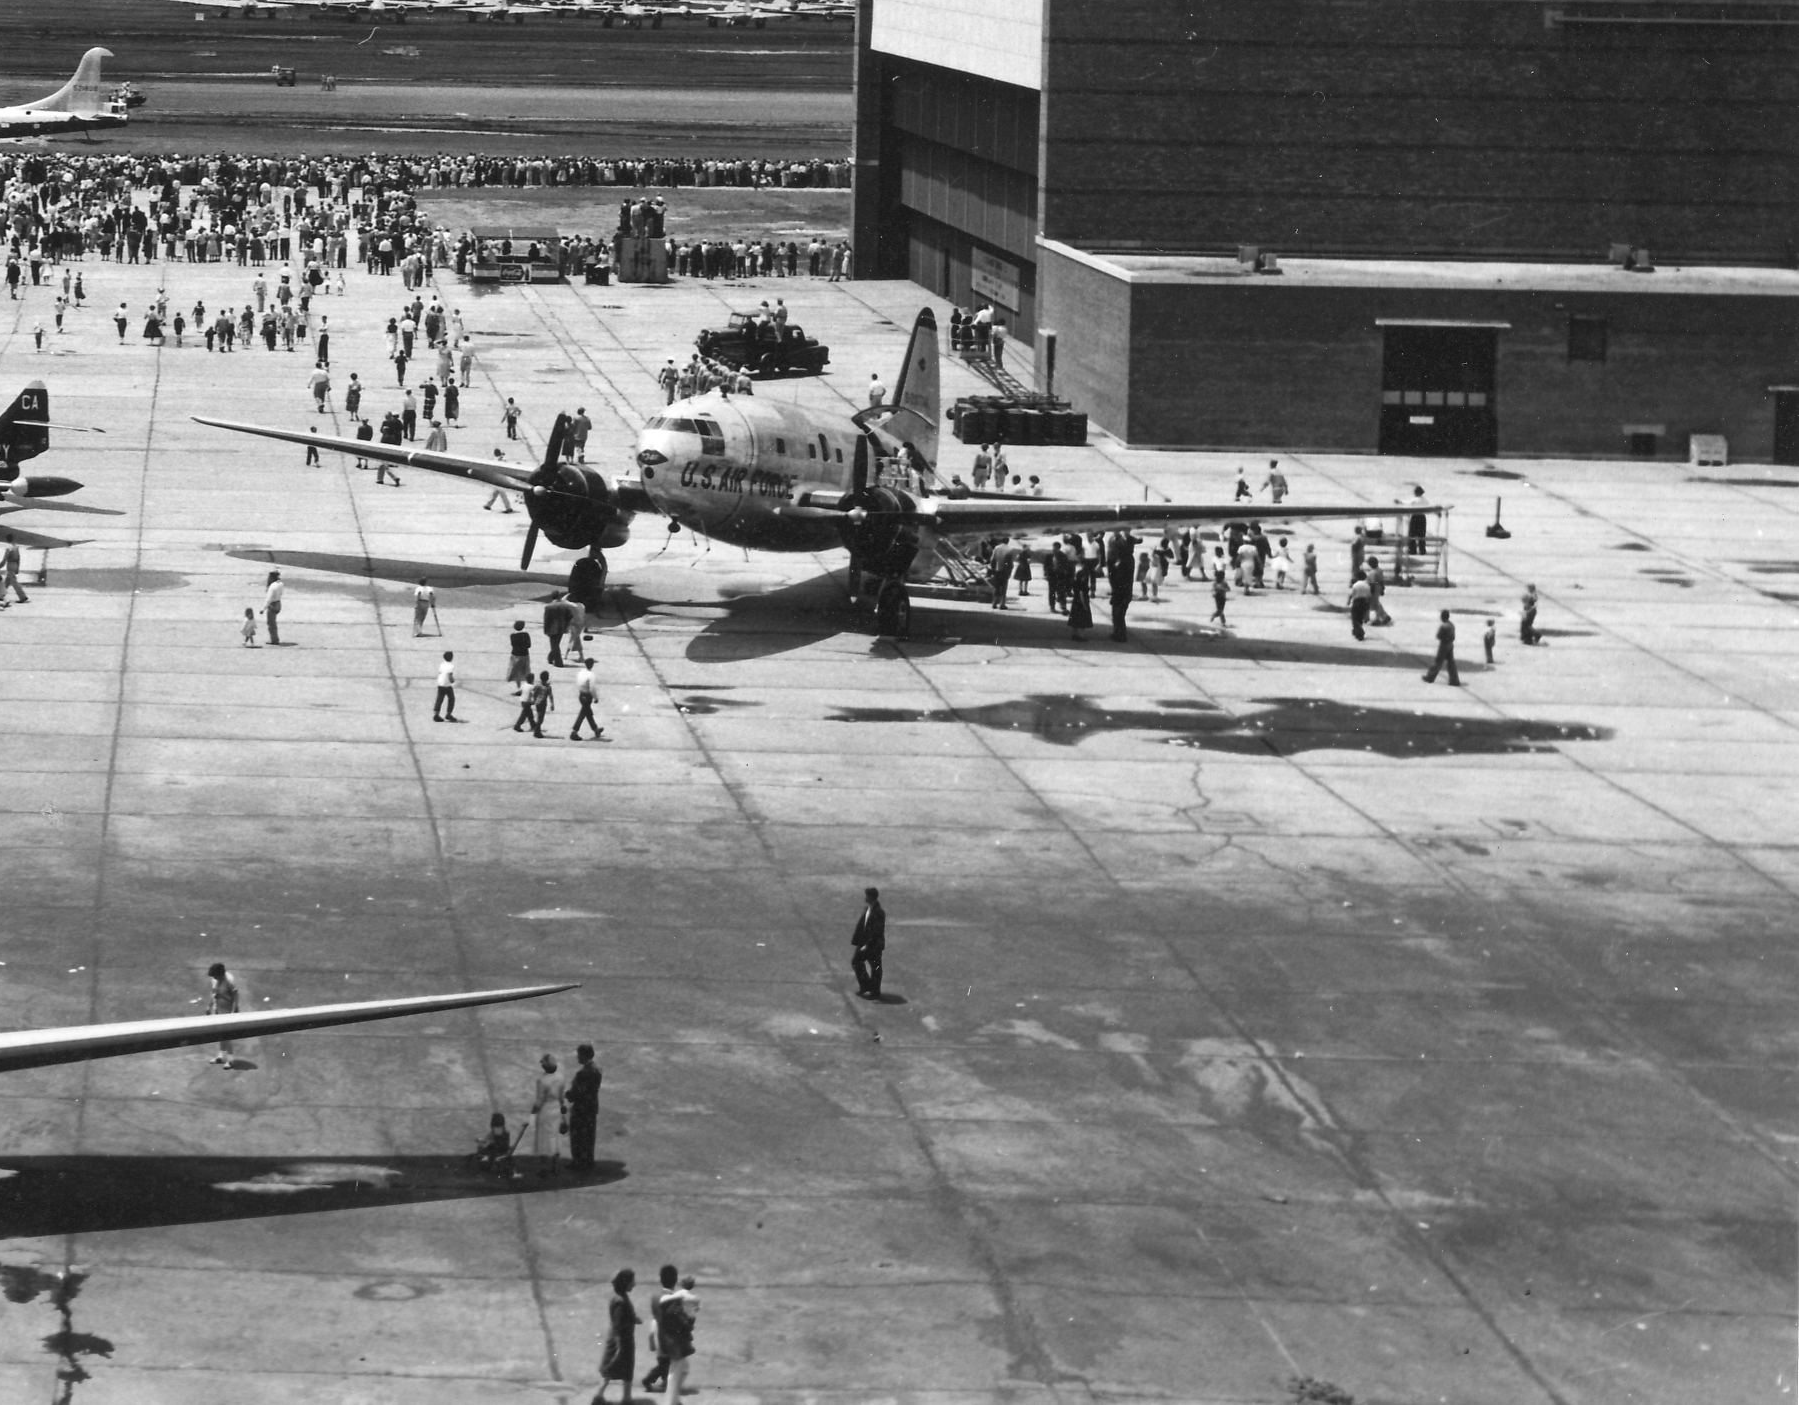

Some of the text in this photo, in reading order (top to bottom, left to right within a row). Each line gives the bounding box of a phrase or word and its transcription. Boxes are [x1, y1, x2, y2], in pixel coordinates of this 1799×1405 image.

[21, 394, 39, 410] CA
[680, 461, 799, 500] U.S. AIR FORCE
